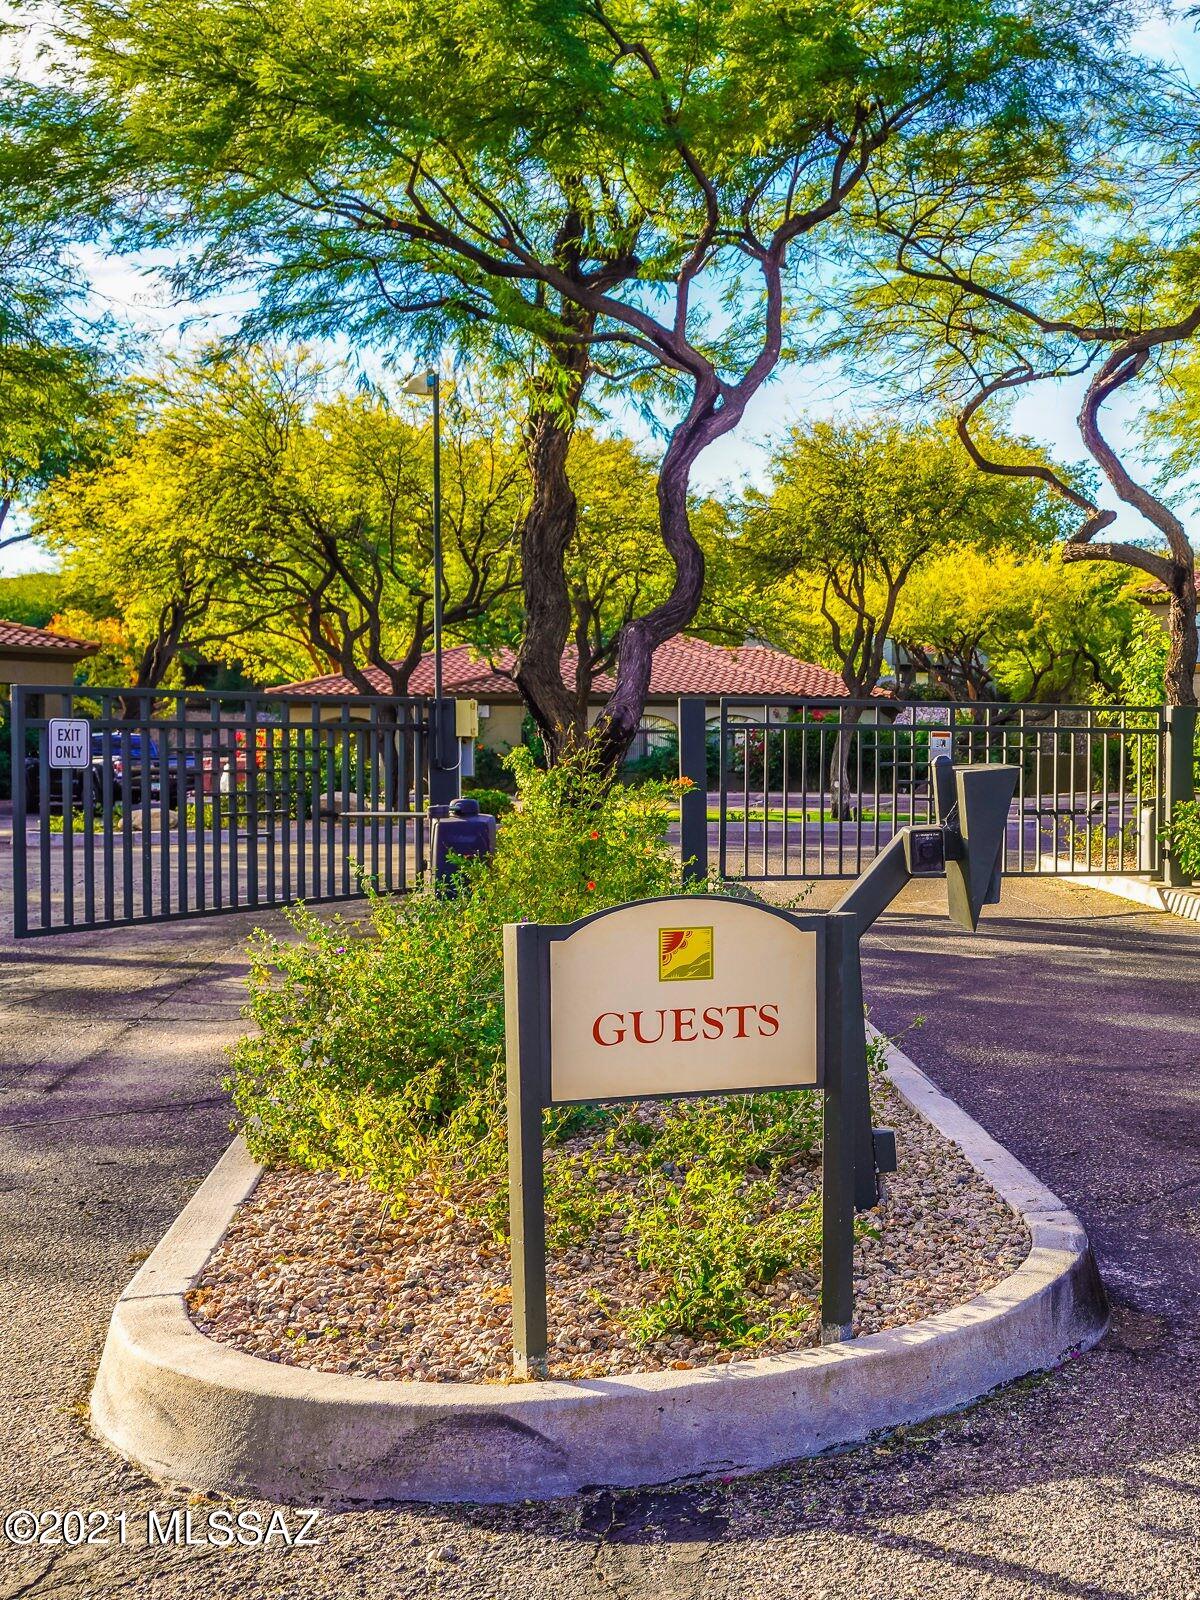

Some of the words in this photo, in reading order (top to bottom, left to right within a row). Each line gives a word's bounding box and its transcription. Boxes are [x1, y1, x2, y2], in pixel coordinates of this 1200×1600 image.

[57, 728, 81, 741] EXIT
[55, 745, 83, 758] ONLY
[592, 1004, 780, 1046] GUESTS
